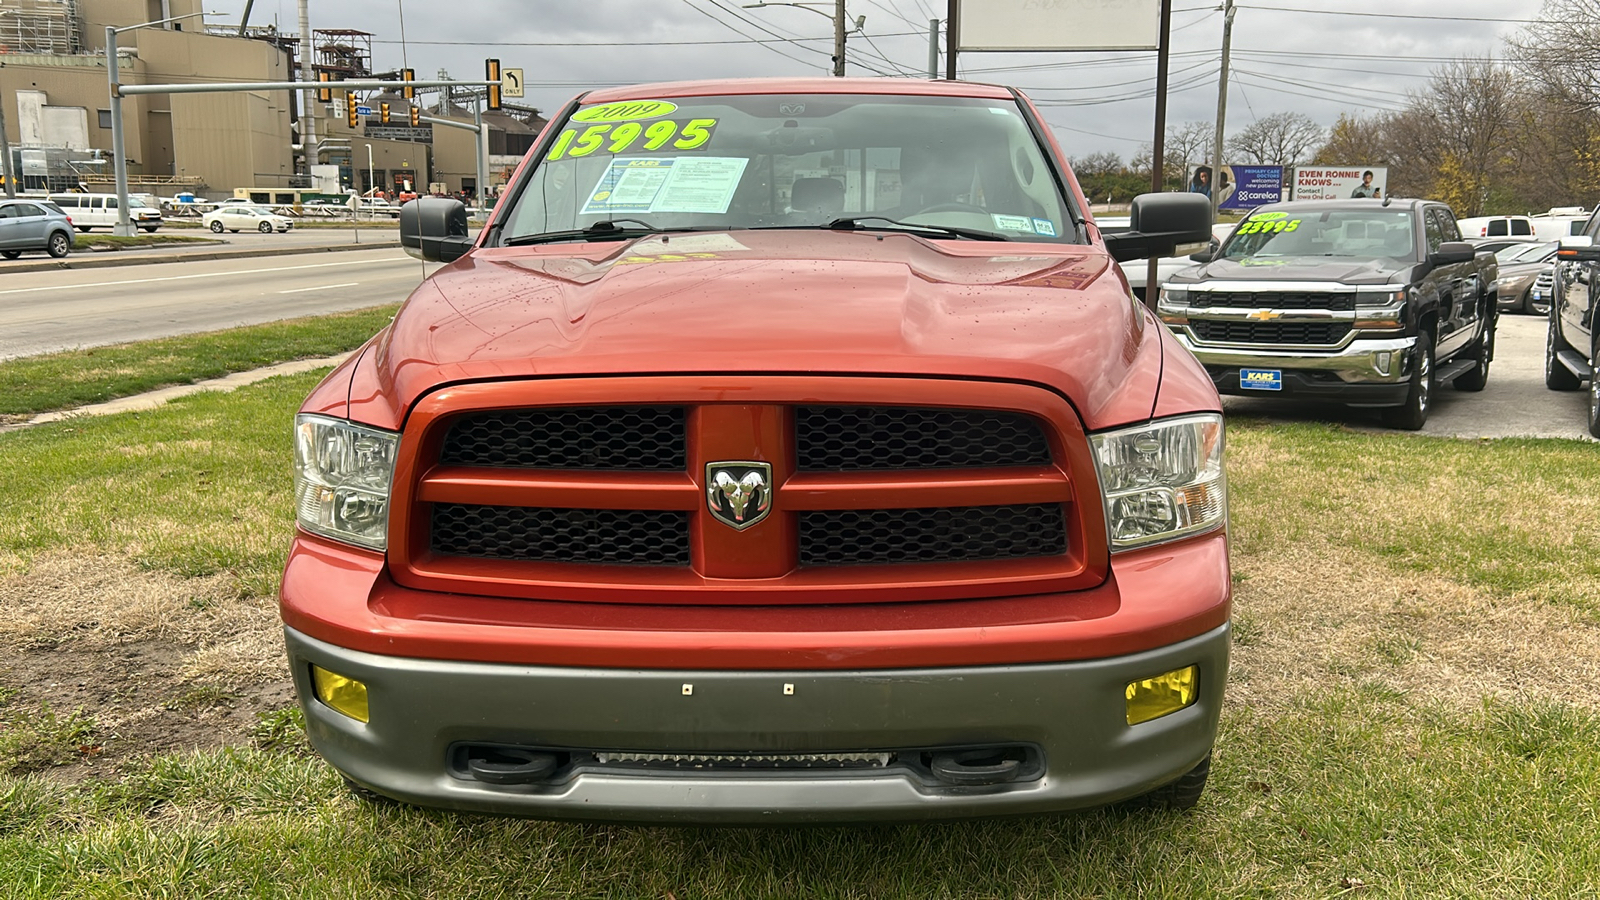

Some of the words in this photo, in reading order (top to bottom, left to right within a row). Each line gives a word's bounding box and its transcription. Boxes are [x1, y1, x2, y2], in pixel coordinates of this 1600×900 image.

[585, 103, 661, 120] 2009
[546, 118, 718, 161] 15995
[1299, 170, 1323, 178] EVEN
[1236, 219, 1301, 235] 23995
[1247, 372, 1274, 381] KARS
